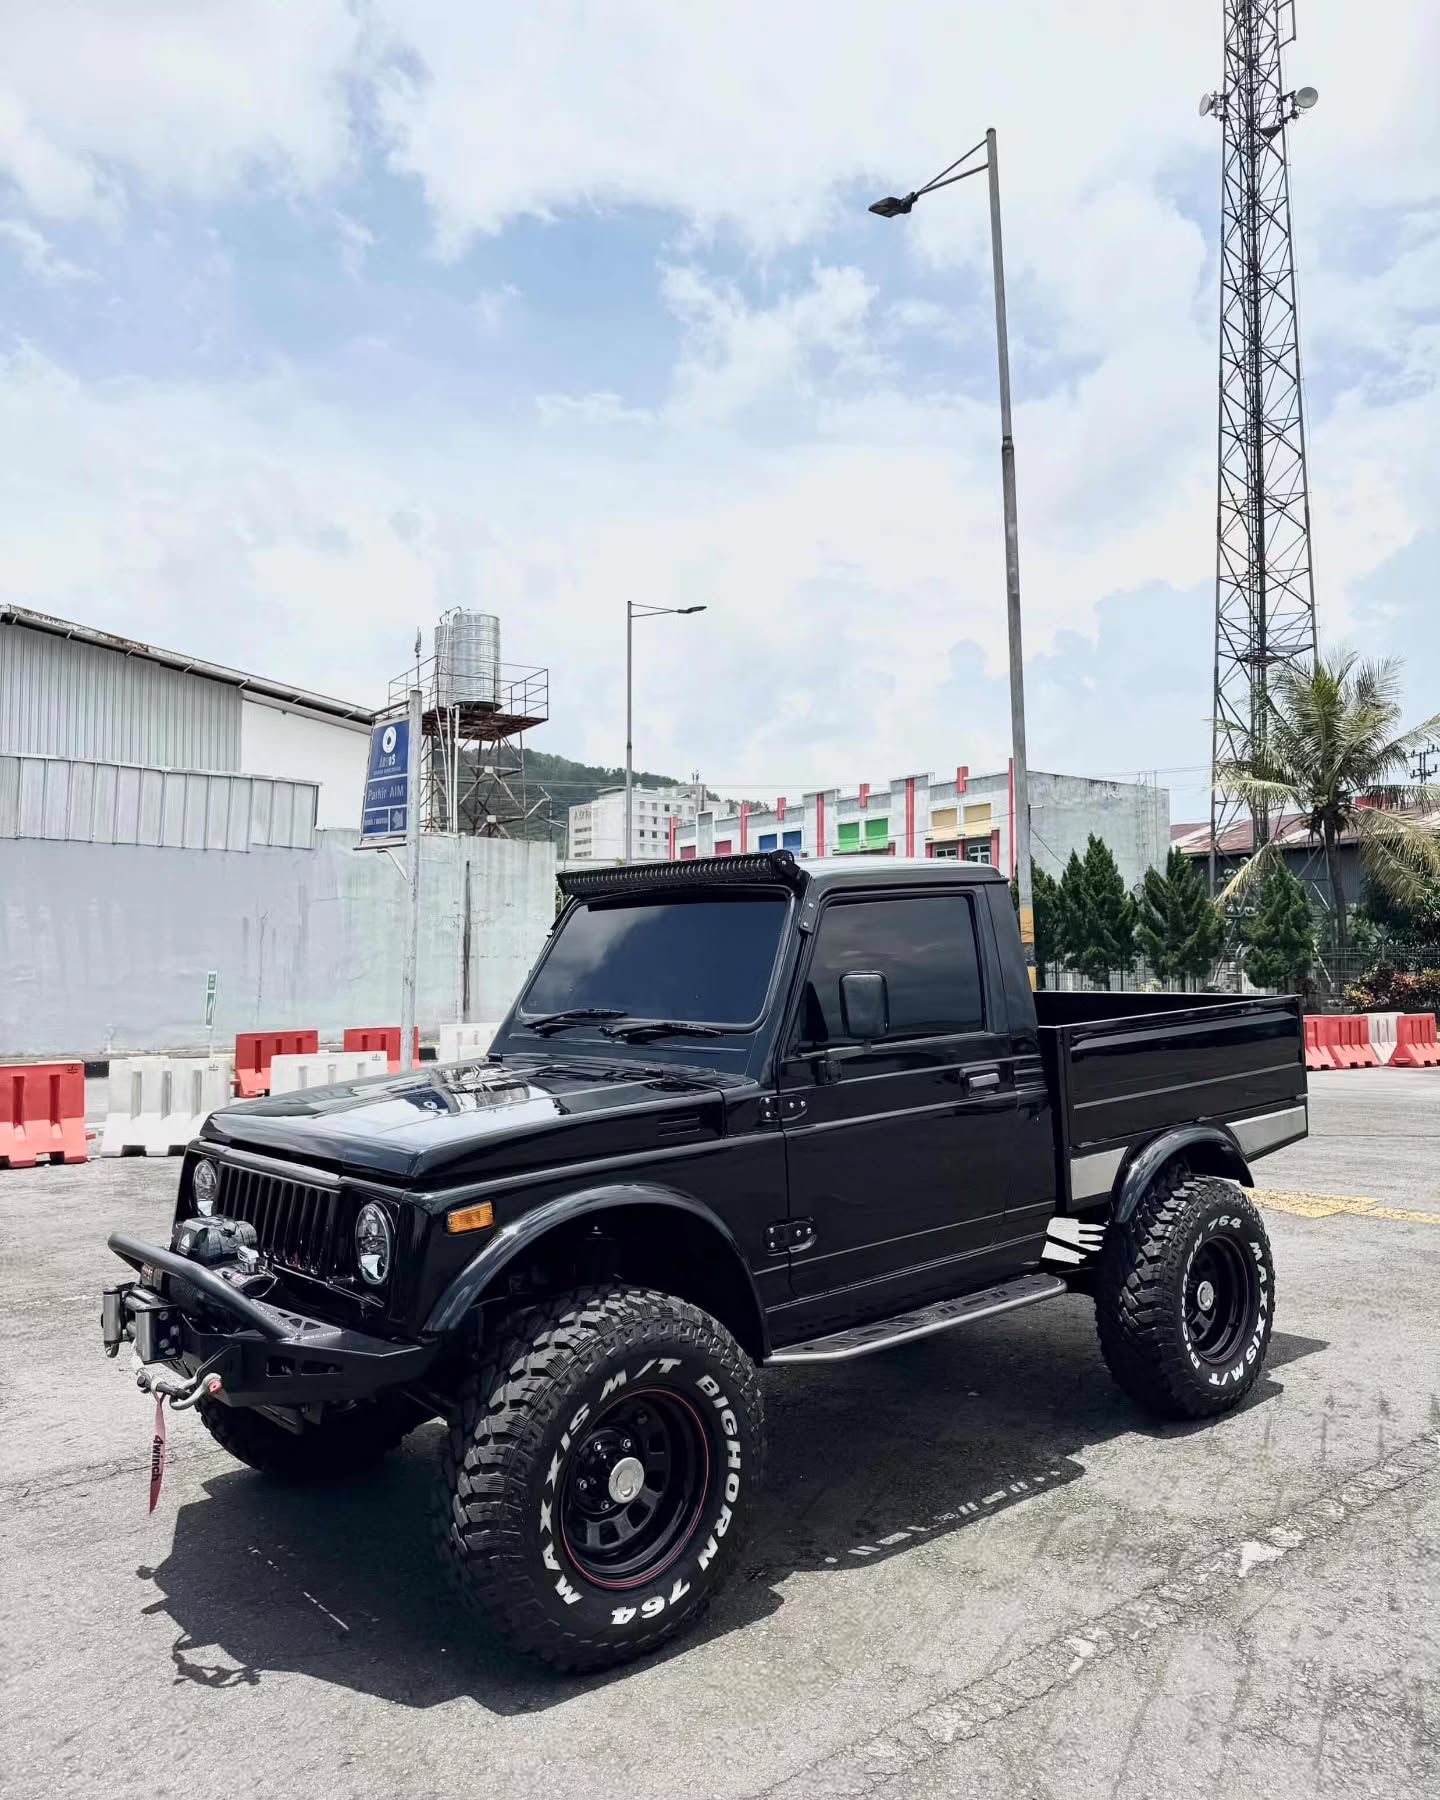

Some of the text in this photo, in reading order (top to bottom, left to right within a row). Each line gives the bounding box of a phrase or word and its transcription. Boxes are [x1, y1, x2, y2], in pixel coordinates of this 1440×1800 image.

[1208, 1215, 1243, 1231] 764
[1208, 1241, 1268, 1386] MAXXIS M/T
[151, 1434, 164, 1481] 4winch
[540, 1357, 682, 1605] MAXXIS M/T
[611, 1374, 742, 1626] BIGHORN 764
